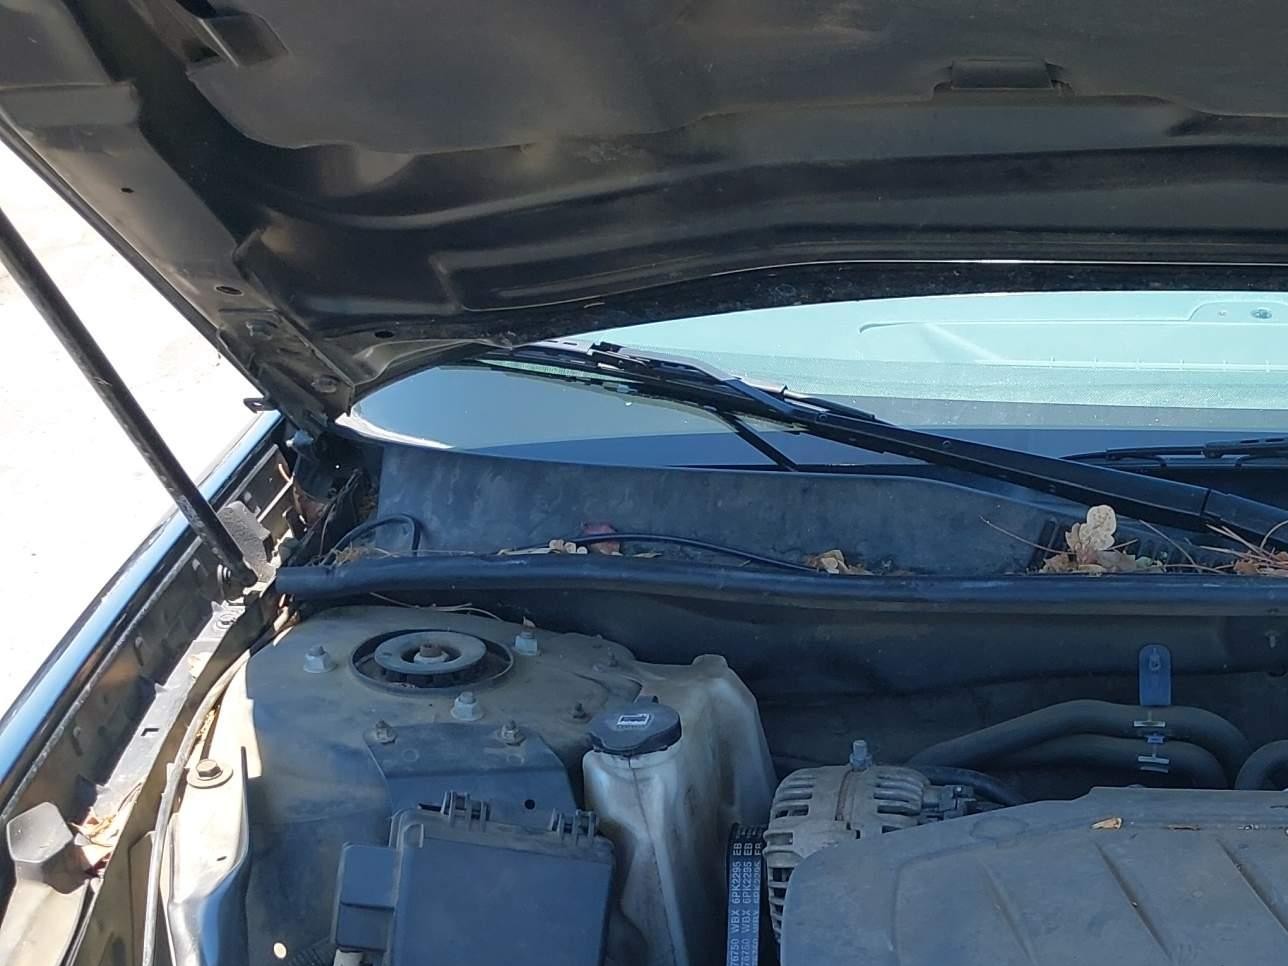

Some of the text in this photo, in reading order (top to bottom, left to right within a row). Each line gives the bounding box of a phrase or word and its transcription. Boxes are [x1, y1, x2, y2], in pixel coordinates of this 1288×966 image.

[733, 842, 743, 856] EB
[743, 842, 754, 856] EB
[731, 860, 742, 904] 6PK2295
[742, 860, 752, 904] 6PK2295
[731, 909, 741, 934] WBX
[741, 909, 751, 934] WBX
